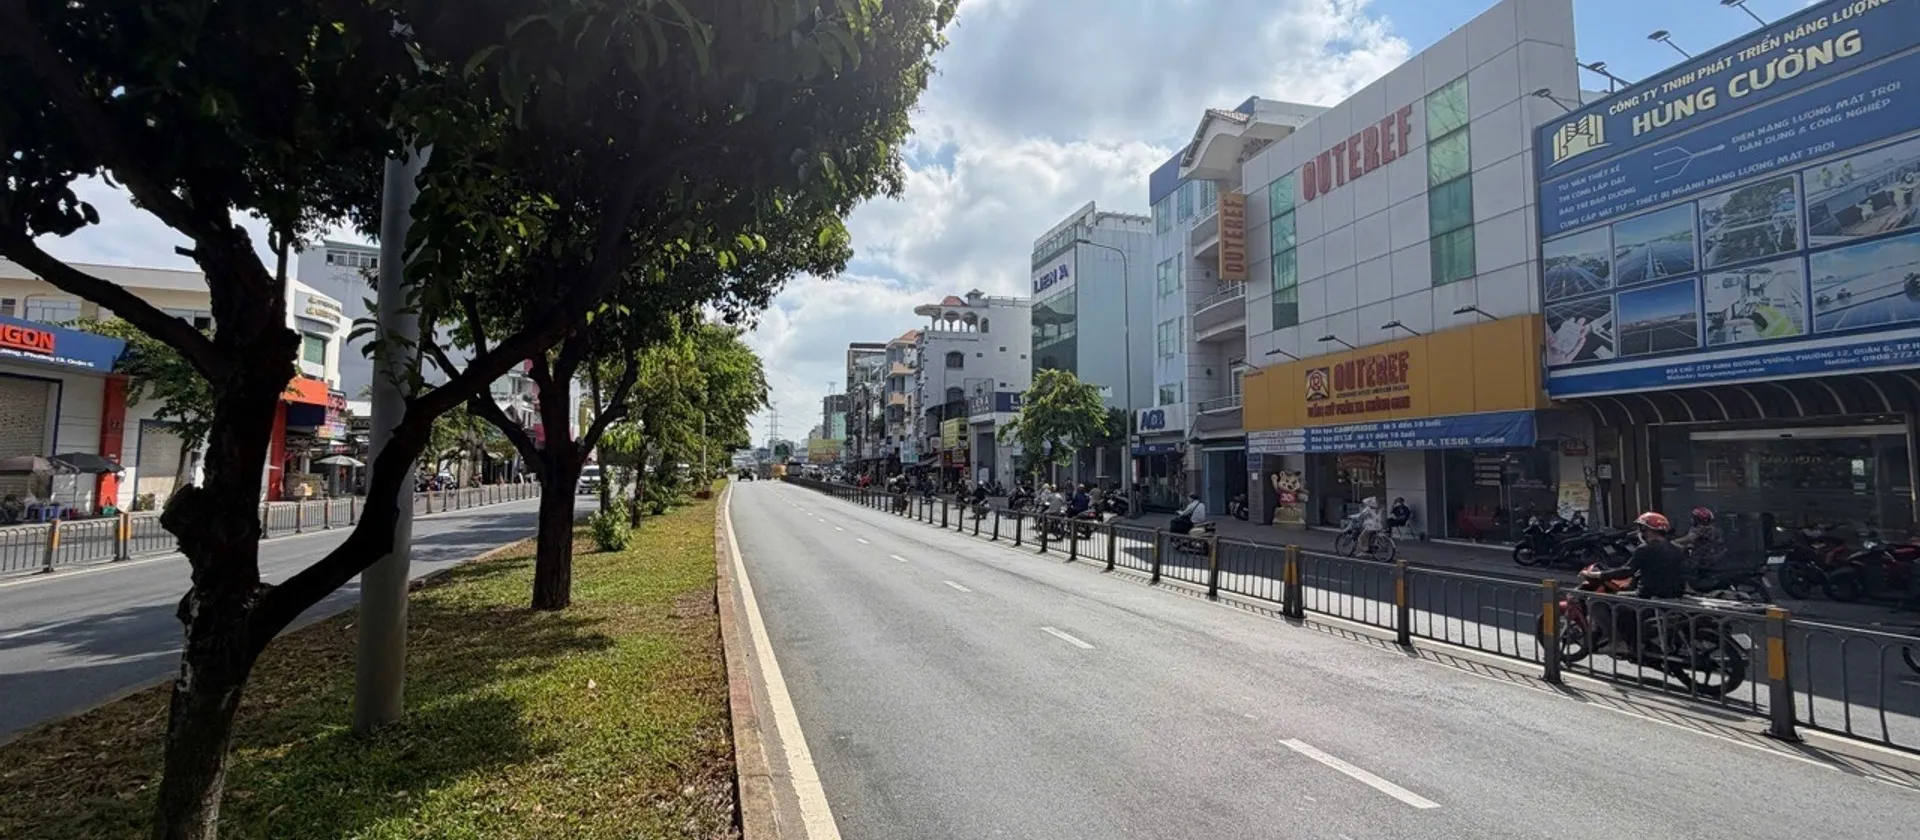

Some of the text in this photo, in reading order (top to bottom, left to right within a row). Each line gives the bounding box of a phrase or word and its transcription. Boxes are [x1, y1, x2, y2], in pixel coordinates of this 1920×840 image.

[1632, 29, 1862, 137] HÙNG CƯỜNG
[1642, 88, 1659, 102] TY
[1661, 72, 1695, 94] TNHH
[1697, 55, 1733, 80] PHÁT
[1832, 0, 1890, 24] LƯỢN
[1302, 104, 1412, 202] OUTEREF
[1223, 198, 1244, 273] OUTEREF
[1334, 350, 1410, 391] OUTEREF
